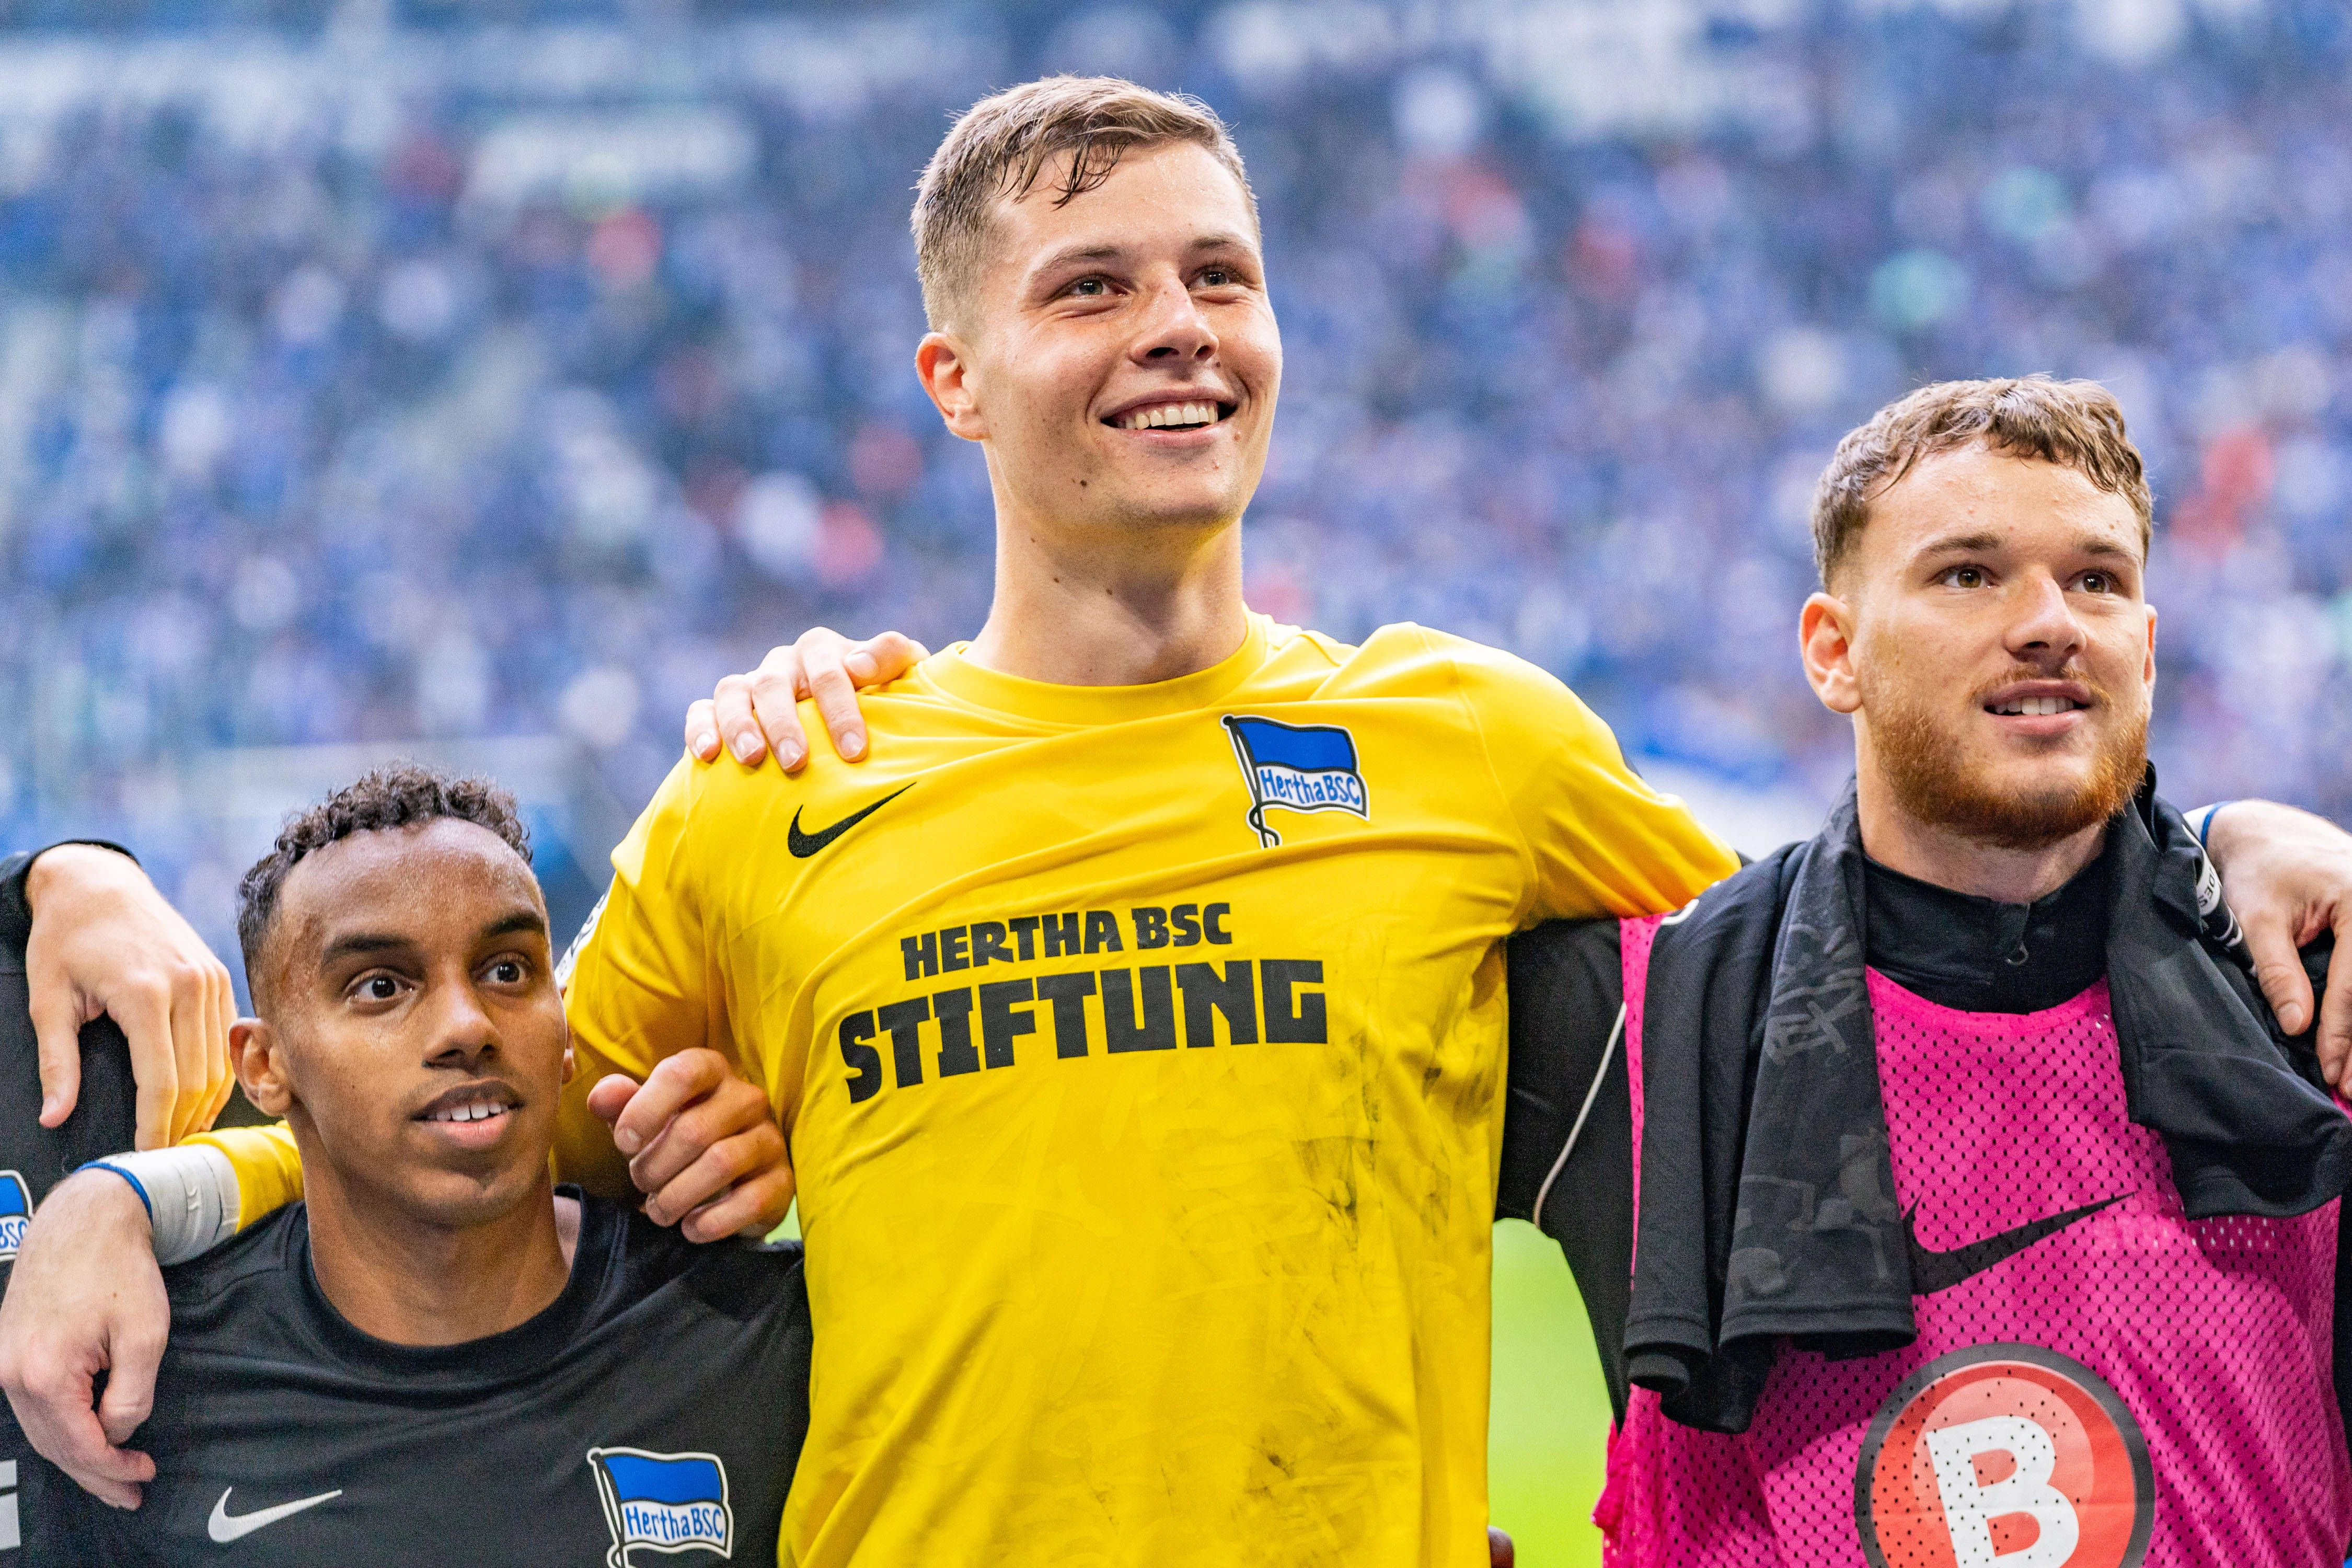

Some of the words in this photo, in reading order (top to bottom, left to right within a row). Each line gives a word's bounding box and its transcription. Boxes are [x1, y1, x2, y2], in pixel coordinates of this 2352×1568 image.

[900, 910, 1124, 982] HERTHA
[1131, 902, 1233, 950] BSC
[838, 959, 1328, 1104] STIFTUNG
[1925, 1415, 2079, 1568] B
